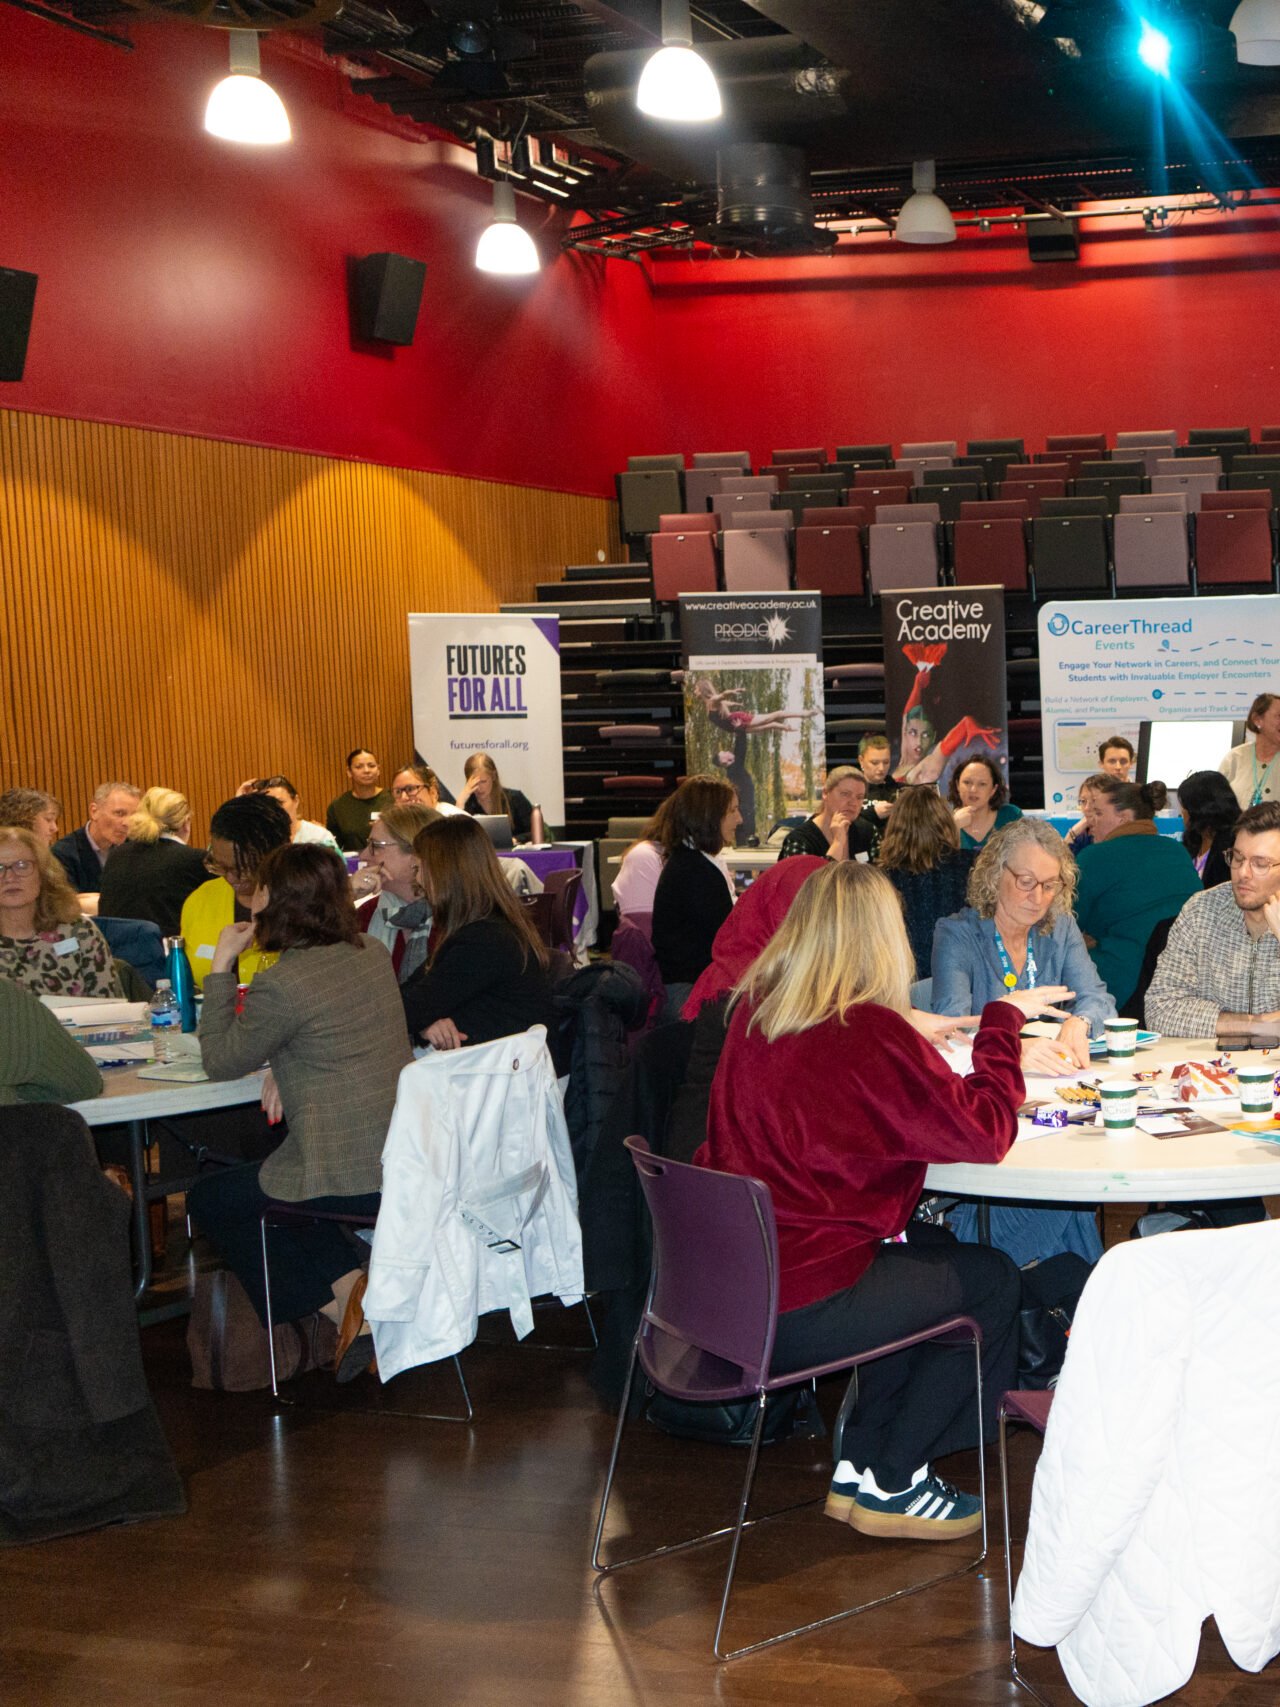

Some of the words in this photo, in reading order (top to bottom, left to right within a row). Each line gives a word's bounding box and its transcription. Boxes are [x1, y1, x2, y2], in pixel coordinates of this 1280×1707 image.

[685, 600, 817, 611] www.creativeacademy.ac.uk
[896, 599, 984, 621] Creative
[897, 620, 992, 643] Academy
[1071, 617, 1192, 635] CareerThread
[1095, 640, 1135, 650] Events
[446, 645, 526, 675] FUTURES
[1058, 661, 1090, 671] Engage
[1093, 660, 1112, 669] Your
[1114, 660, 1152, 668] Network
[1165, 659, 1200, 668] Careers,
[1203, 658, 1220, 667] and
[1222, 657, 1258, 666] Connect
[1261, 656, 1280, 665] Your
[1068, 674, 1106, 682] Students
[1109, 673, 1128, 681] with
[1131, 672, 1175, 680] Invaluable
[1178, 672, 1219, 681] Employer
[1222, 670, 1272, 679] Encounters
[448, 677, 486, 712] FOR
[490, 677, 528, 711] ALL
[450, 740, 529, 752] futuresforall.org
